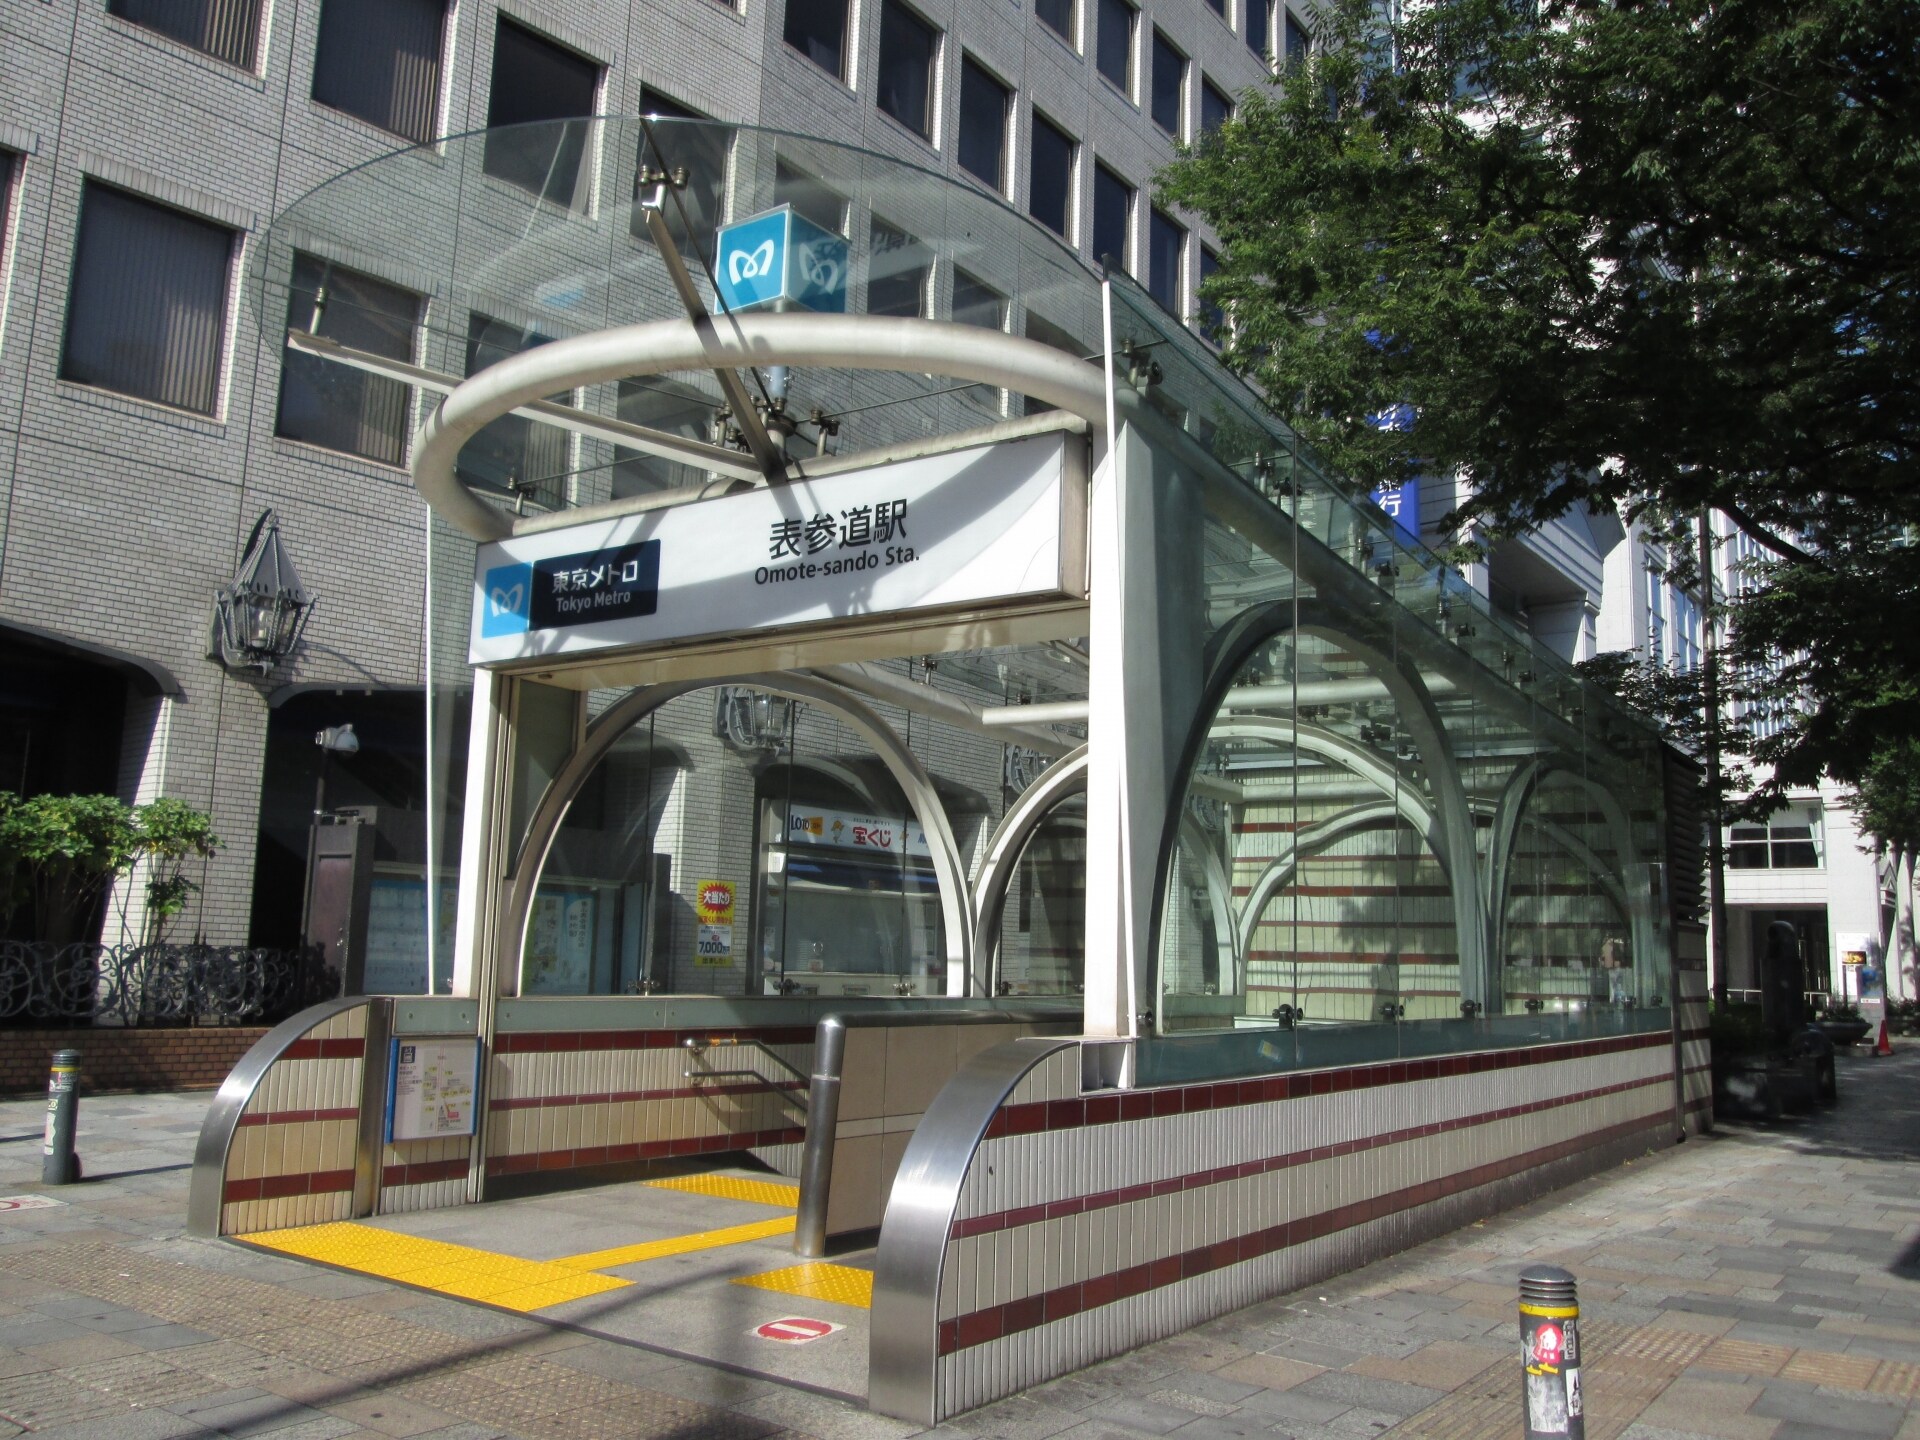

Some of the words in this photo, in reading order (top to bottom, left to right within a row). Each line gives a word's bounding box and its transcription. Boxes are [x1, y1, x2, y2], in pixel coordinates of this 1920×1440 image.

[769, 498, 908, 560] 表参道駅
[552, 560, 638, 594] 東京メトロ
[755, 550, 879, 585] Omote-sando
[885, 546, 920, 566] Sta.
[556, 596, 591, 614] Tokyo
[594, 591, 631, 608] Metro
[852, 826, 892, 848] 宝くじ
[703, 891, 730, 905] 大当たり
